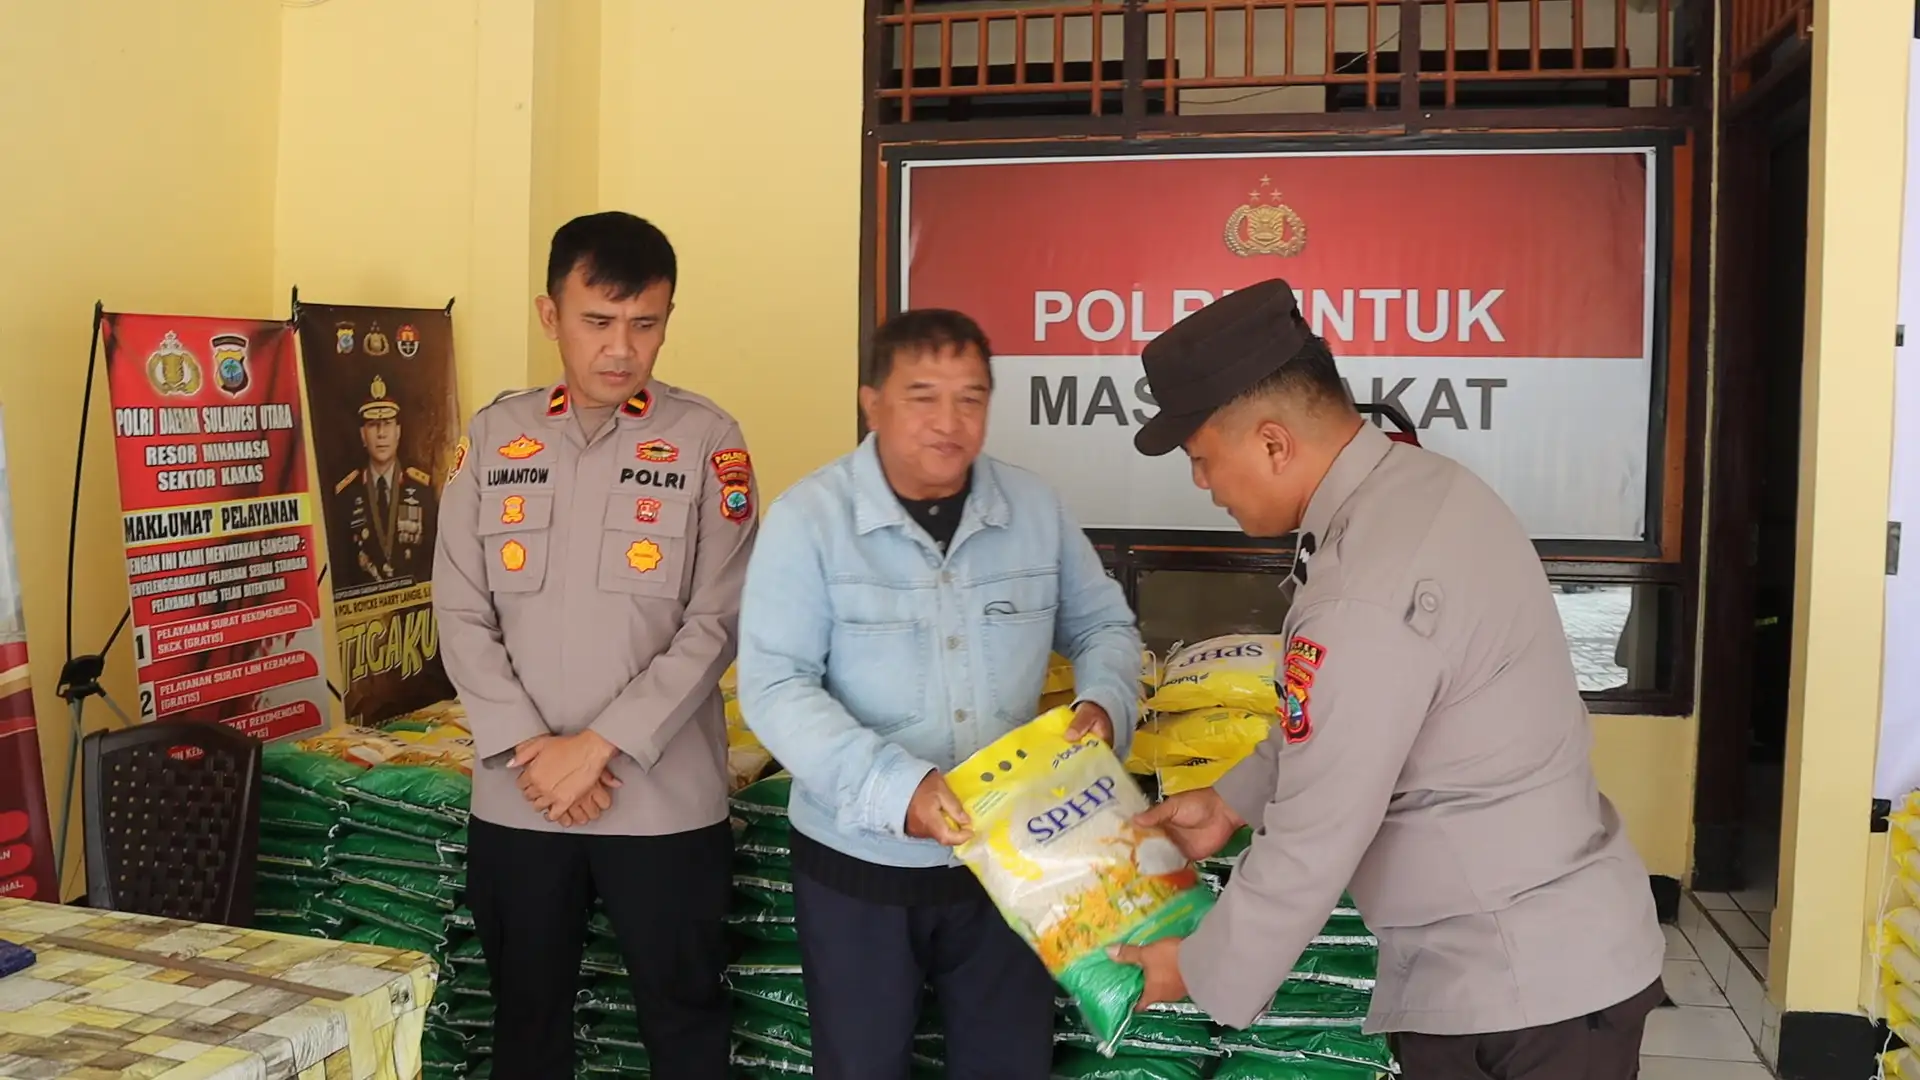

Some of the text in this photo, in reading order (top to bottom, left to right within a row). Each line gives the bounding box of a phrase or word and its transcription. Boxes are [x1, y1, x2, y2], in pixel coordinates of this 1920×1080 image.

[1034, 289, 1240, 342] POLR
[115, 408, 154, 436] POLRI
[202, 405, 257, 433] SULAWESI
[259, 404, 293, 430] UTARA
[145, 440, 270, 466] RESOR MINAHASA
[158, 465, 264, 491] SEKTOR KAKAS
[620, 468, 686, 490] POLRI
[124, 499, 299, 543] MAKLUMAT PELAYANAN
[162, 551, 177, 570] INI
[178, 548, 205, 568] KAMI
[205, 540, 261, 564] MENYATAKAN
[156, 604, 297, 641] PELAYANAN SURAT REKOMENDASI
[135, 634, 145, 660] 1
[160, 677, 212, 696] PELAYANAN
[213, 668, 242, 683] SURAT
[140, 690, 153, 718] 2
[249, 704, 306, 727] REKOMENDASI
[1027, 776, 1117, 843] SPHP
